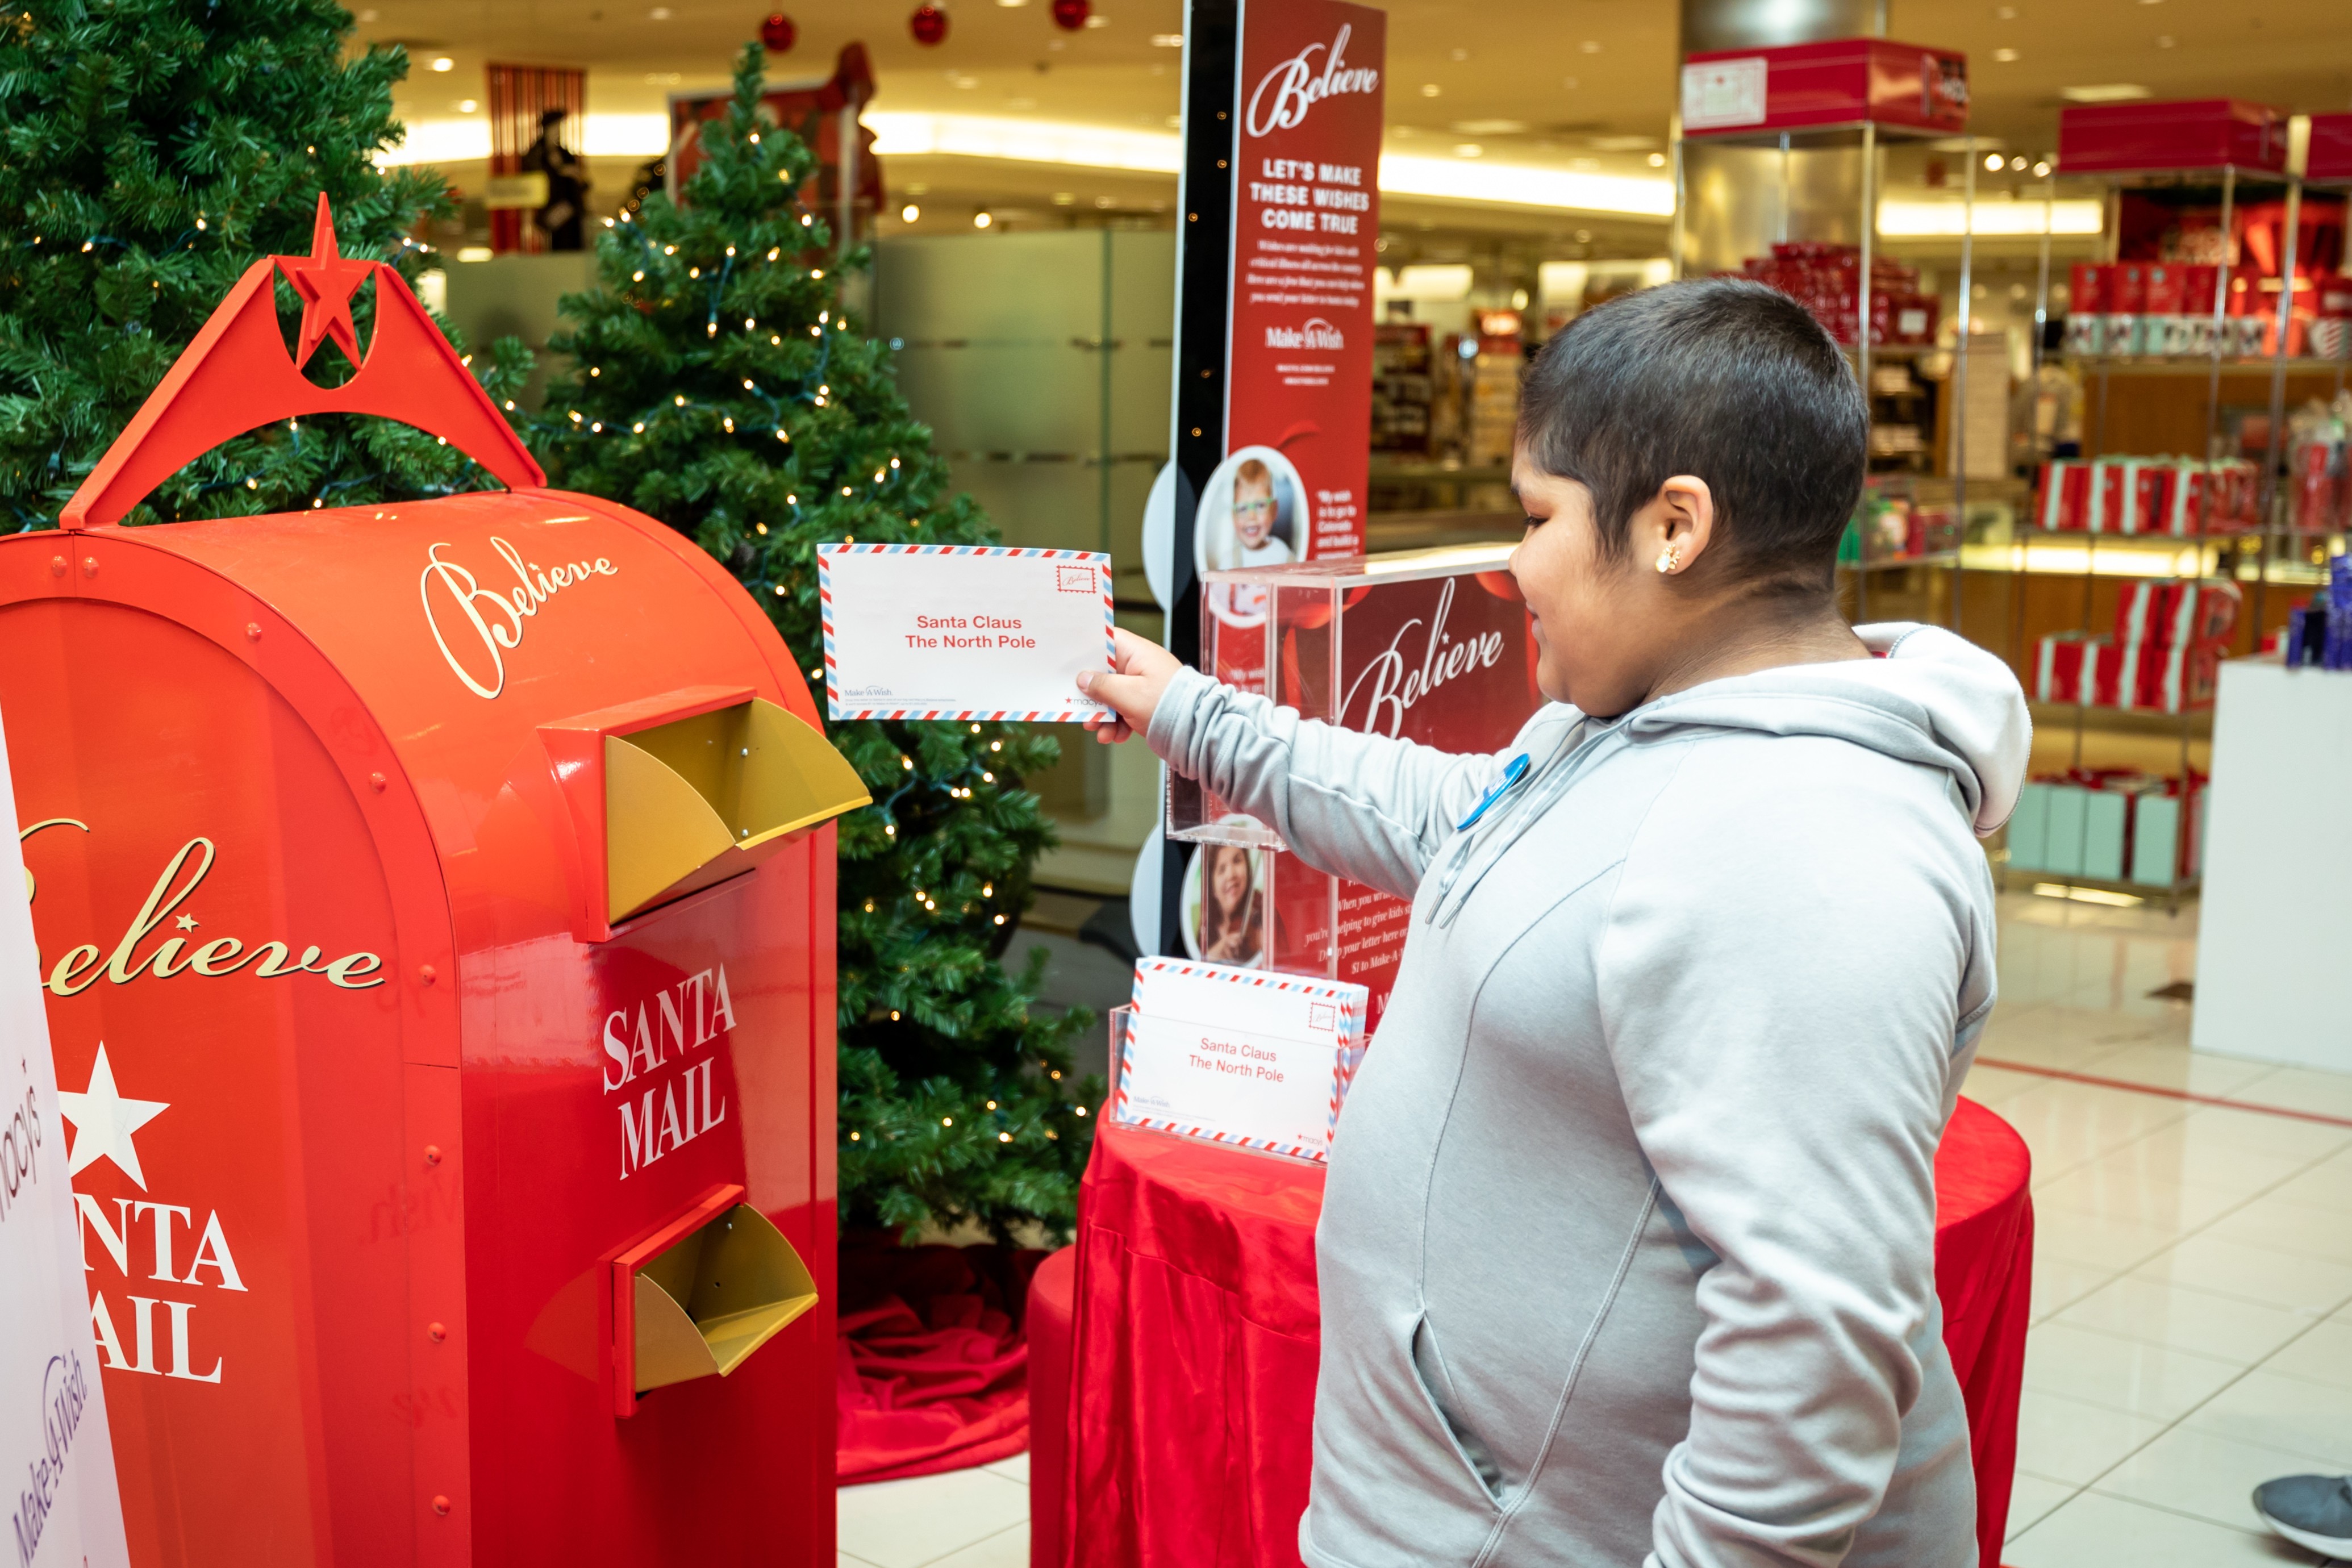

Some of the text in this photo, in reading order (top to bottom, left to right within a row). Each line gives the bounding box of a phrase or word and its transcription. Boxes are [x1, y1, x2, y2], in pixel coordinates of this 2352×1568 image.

[1246, 23, 1378, 138] Believe
[1262, 158, 1362, 186] LET'S MAKE
[1249, 182, 1370, 212] THESE WISHES
[1261, 208, 1358, 235] COME TRUE
[420, 536, 618, 699] Believe
[917, 615, 1022, 629] Santa Claus
[905, 635, 1036, 648] The North Pole
[19, 818, 386, 997] elieve
[1364, 916, 1371, 927] to
[1372, 911, 1387, 928] give
[1388, 905, 1403, 919] kids
[1342, 942, 1361, 959] your
[1362, 936, 1381, 949] letter
[1383, 931, 1398, 943] here
[1361, 961, 1368, 971] to
[603, 962, 736, 1095] SANTA
[1200, 1037, 1277, 1062] Santa Claus
[1190, 1054, 1284, 1082] The North Pole
[618, 1057, 725, 1181] MAIL
[72, 1193, 248, 1292] NTA
[90, 1289, 222, 1384] AIL
